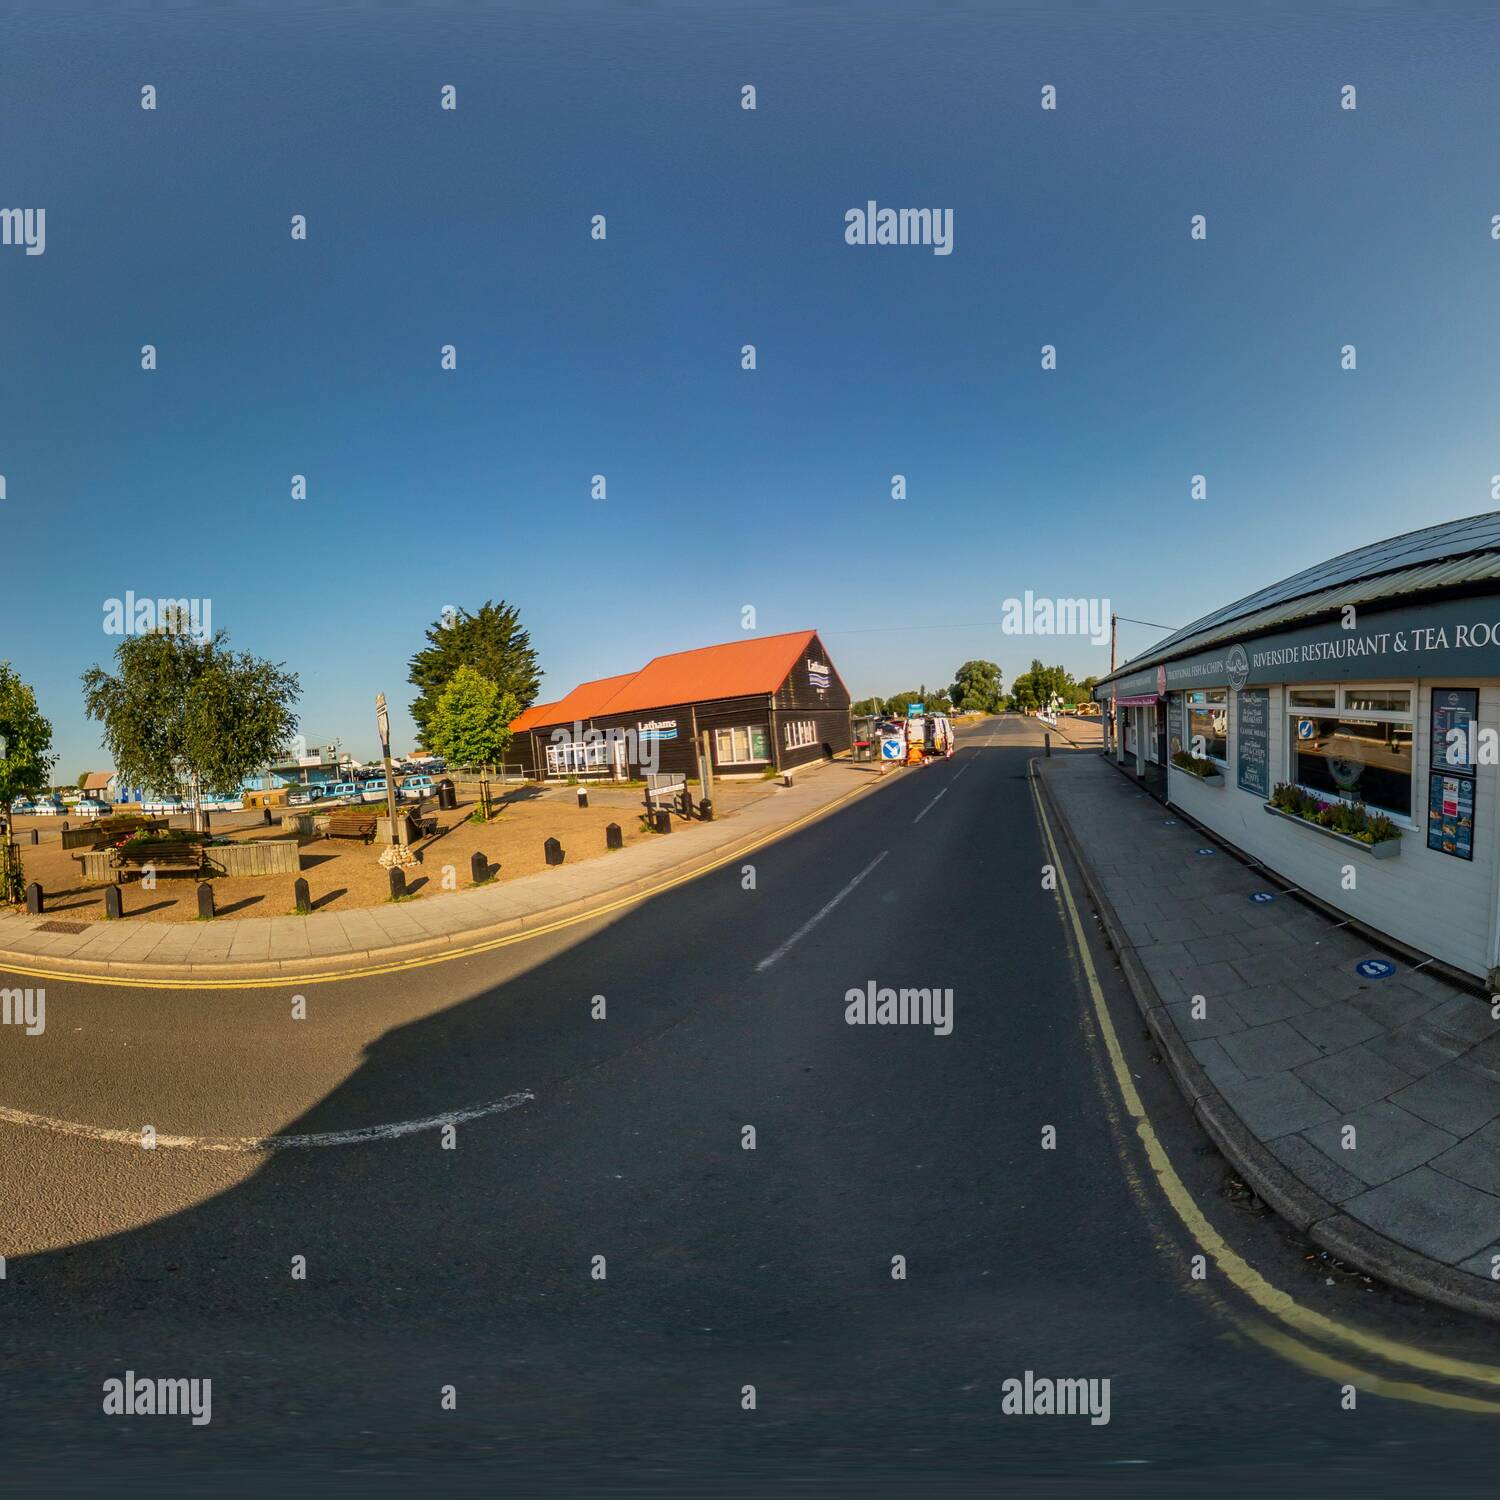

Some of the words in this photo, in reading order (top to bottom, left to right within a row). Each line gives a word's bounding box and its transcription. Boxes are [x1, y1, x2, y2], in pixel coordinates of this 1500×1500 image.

[1252, 646, 1300, 668] RIVERSIDE
[1301, 633, 1391, 662] RESTAURANT
[1393, 631, 1409, 653] &
[1411, 627, 1451, 651] TEA
[1191, 664, 1202, 677] FISH
[1206, 661, 1224, 674] CHIPS
[637, 719, 678, 732] Lathams
